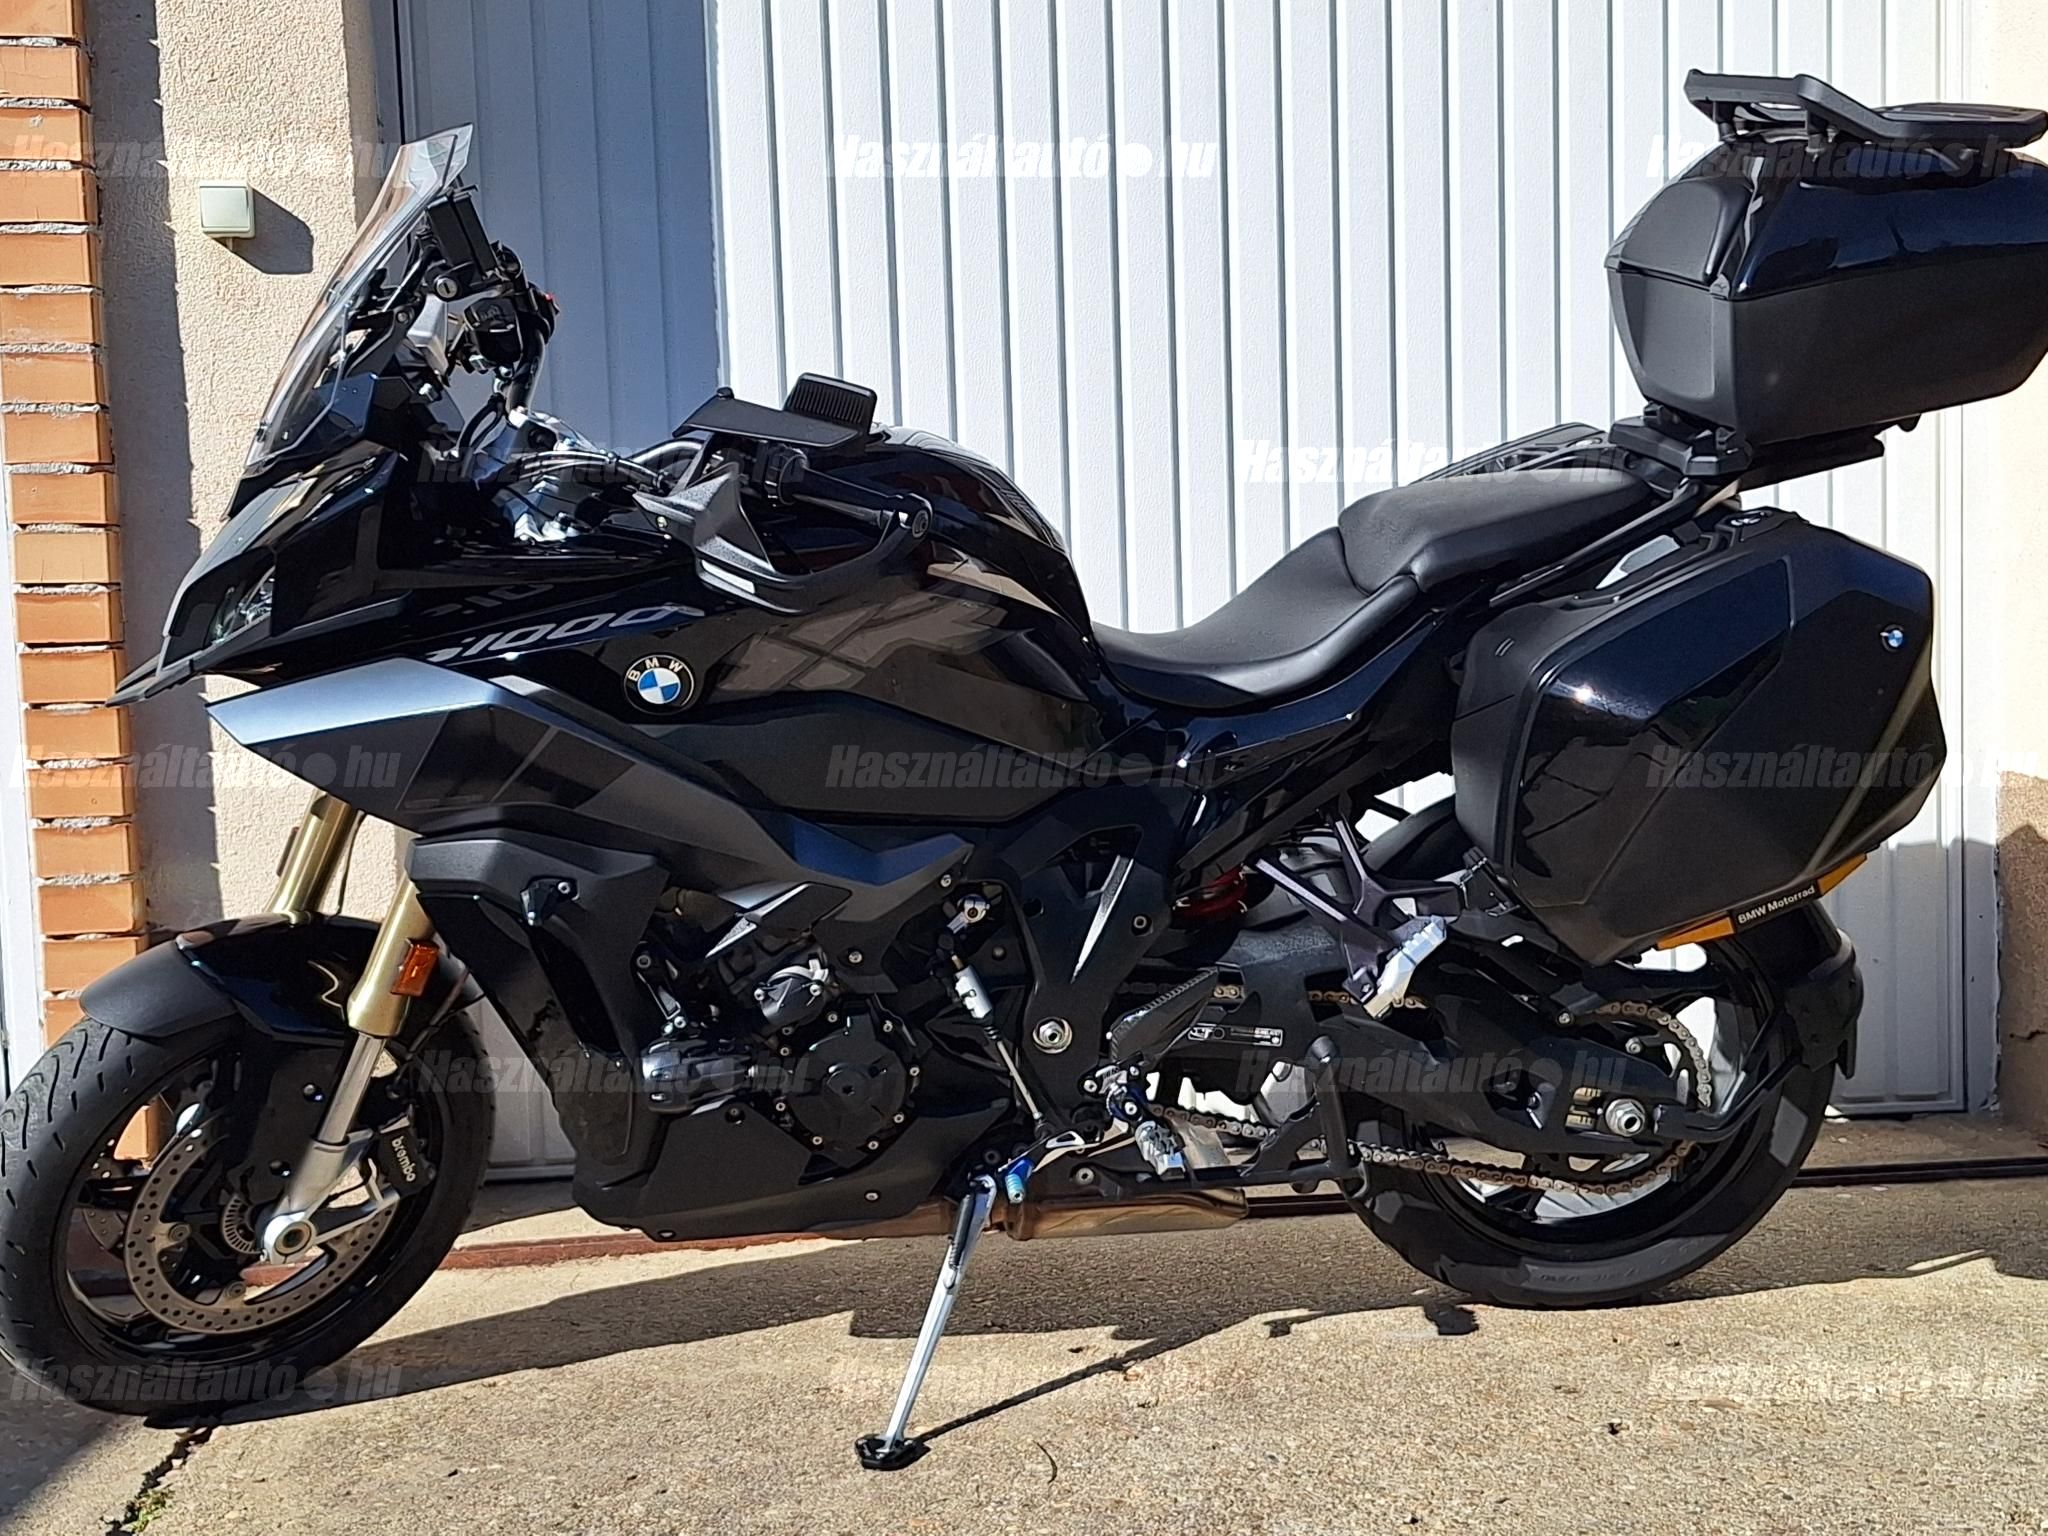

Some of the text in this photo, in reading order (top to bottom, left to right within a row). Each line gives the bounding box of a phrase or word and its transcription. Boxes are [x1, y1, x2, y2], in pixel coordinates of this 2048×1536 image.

[627, 656, 684, 682] BMW
[1737, 884, 1816, 924] BMW Motorrad
[391, 1135, 417, 1182] brembo
